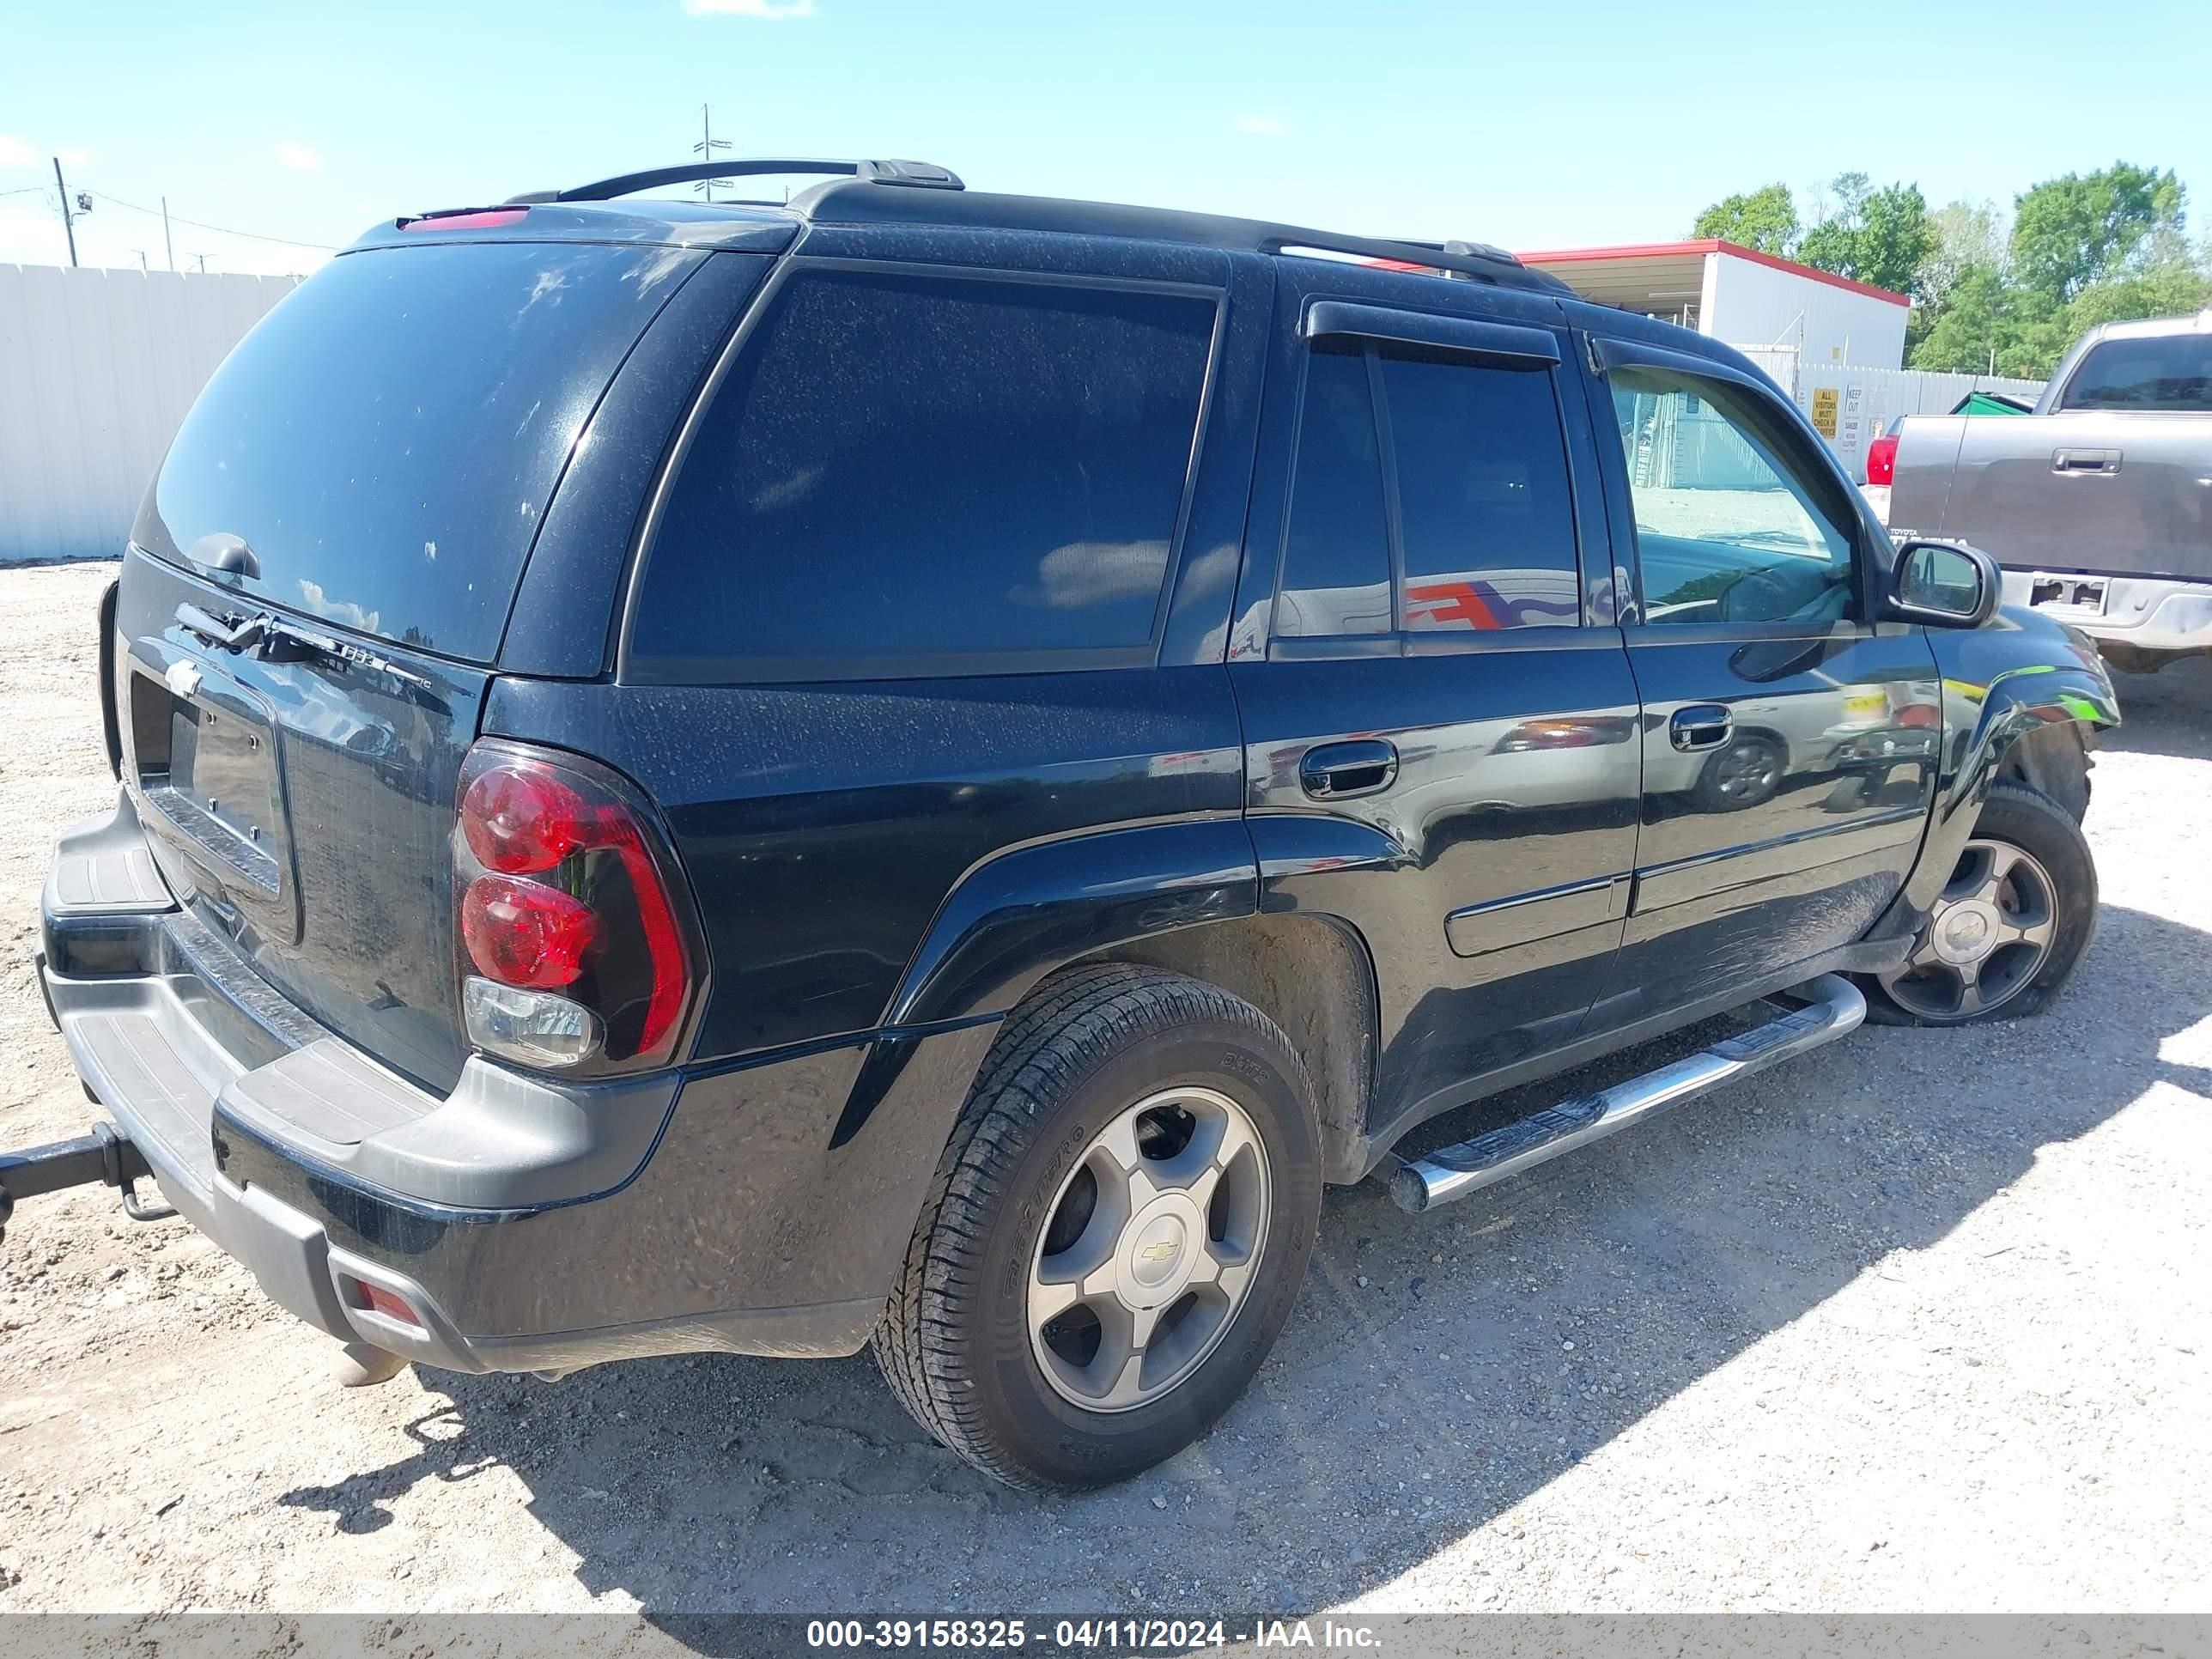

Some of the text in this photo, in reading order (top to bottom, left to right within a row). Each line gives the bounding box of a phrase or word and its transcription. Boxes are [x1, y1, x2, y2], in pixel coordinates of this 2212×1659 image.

[1821, 391, 1831, 399] ALL
[1849, 390, 1862, 398] KEEP
[1849, 403, 1858, 411] OUT
[1890, 528, 1917, 537] TOYOTA
[1220, 1052, 1270, 1085] DHT2
